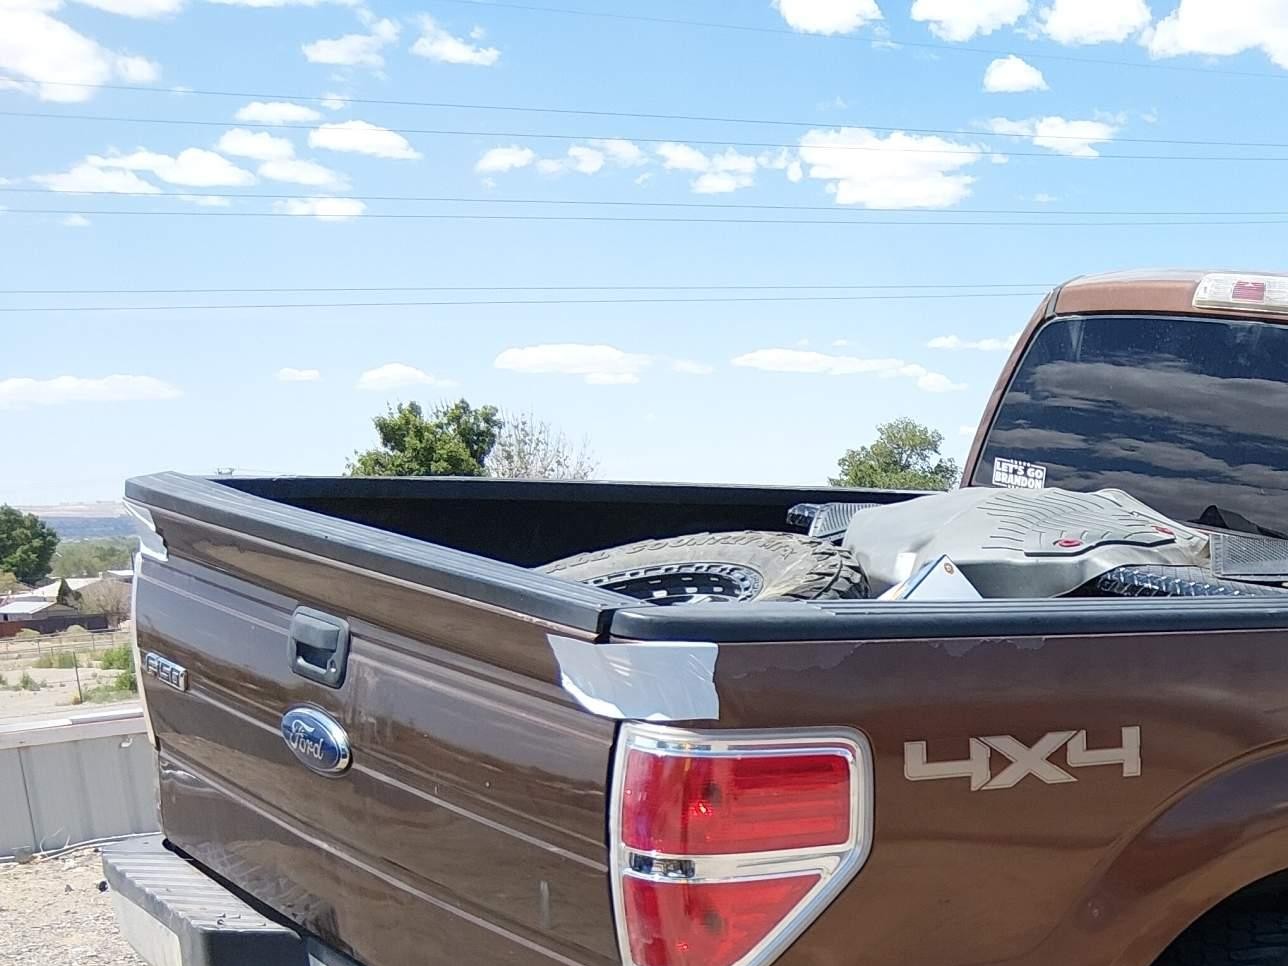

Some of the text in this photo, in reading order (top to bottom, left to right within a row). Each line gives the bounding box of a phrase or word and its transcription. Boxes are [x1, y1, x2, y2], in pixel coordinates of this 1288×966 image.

[994, 471, 1042, 489] BRANDON
[996, 460, 1044, 480] LET'S GO
[289, 719, 325, 760] Ford
